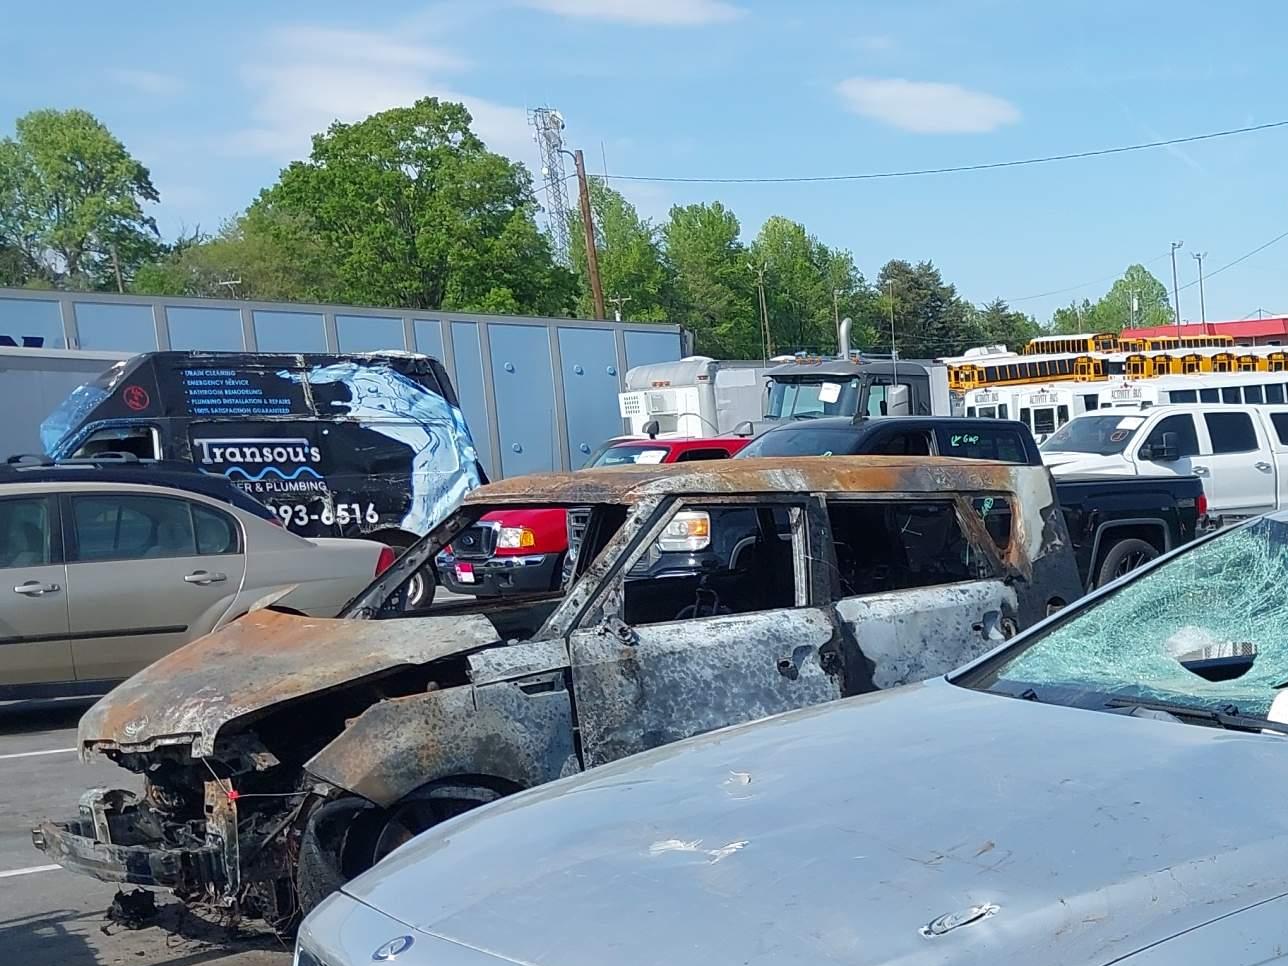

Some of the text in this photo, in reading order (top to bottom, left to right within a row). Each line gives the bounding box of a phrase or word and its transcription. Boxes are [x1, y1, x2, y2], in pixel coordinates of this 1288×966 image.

[1132, 388, 1142, 398] BUS
[193, 438, 321, 465] Transou's
[255, 482, 264, 493] &
[265, 481, 327, 493] PLUMBING
